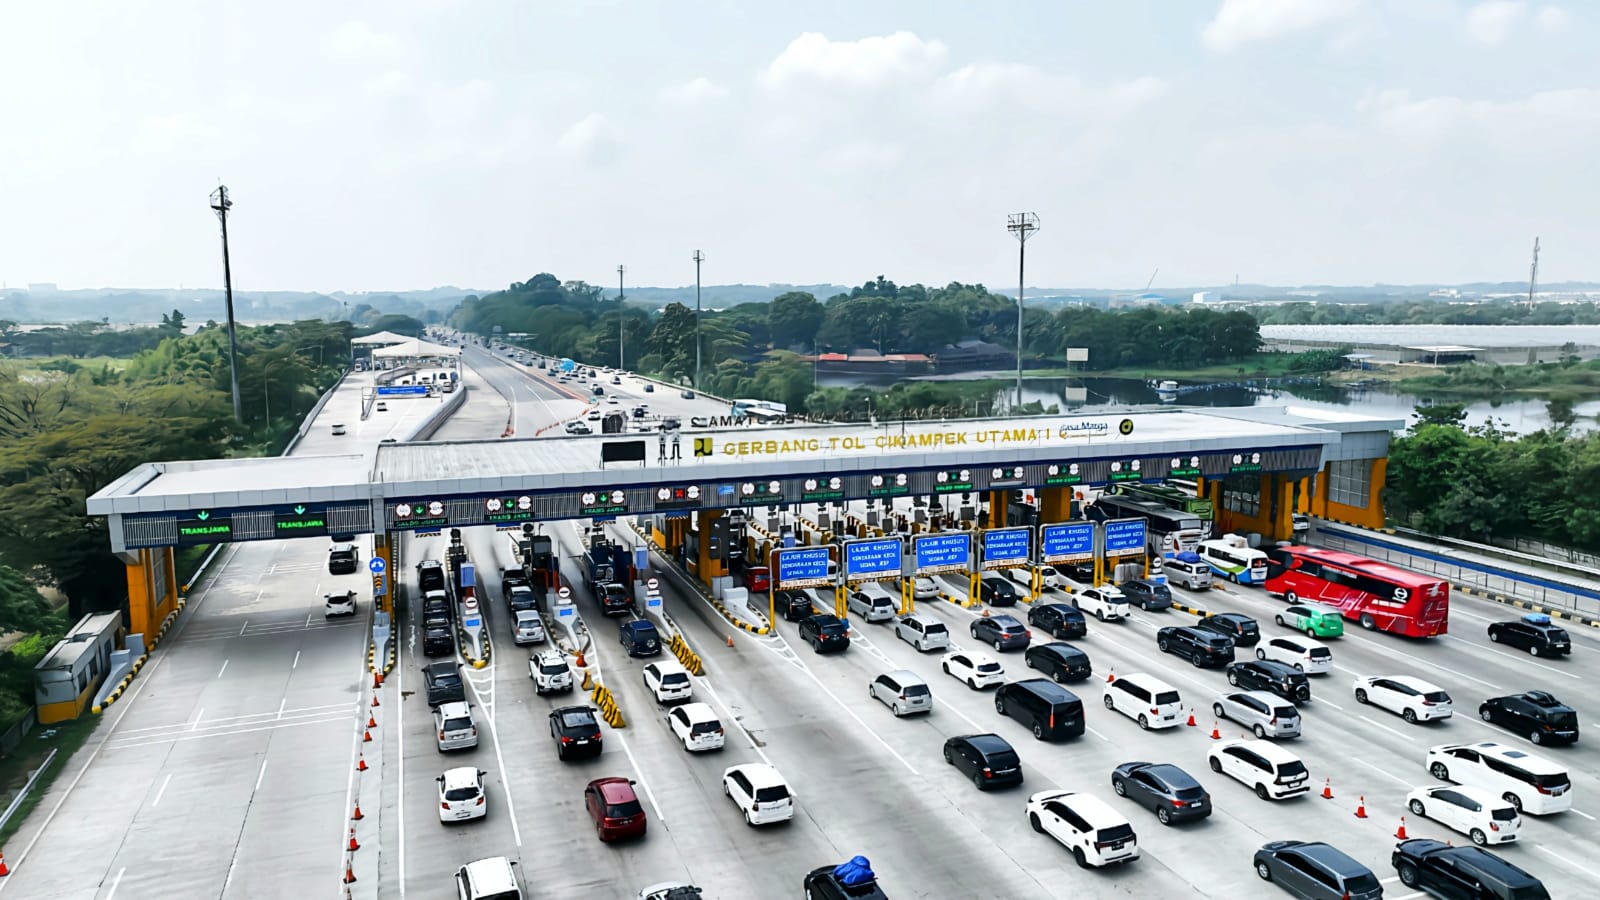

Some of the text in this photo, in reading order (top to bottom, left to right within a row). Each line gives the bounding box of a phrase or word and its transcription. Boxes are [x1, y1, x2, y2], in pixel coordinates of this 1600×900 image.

[723, 439, 819, 456] GERBANG
[829, 437, 865, 450] TOL
[874, 432, 967, 448] CIKAMPEK
[976, 428, 1037, 443] UTAMA
[277, 520, 323, 529] TRANSJAWA
[180, 526, 230, 535] TRANSJAWA
